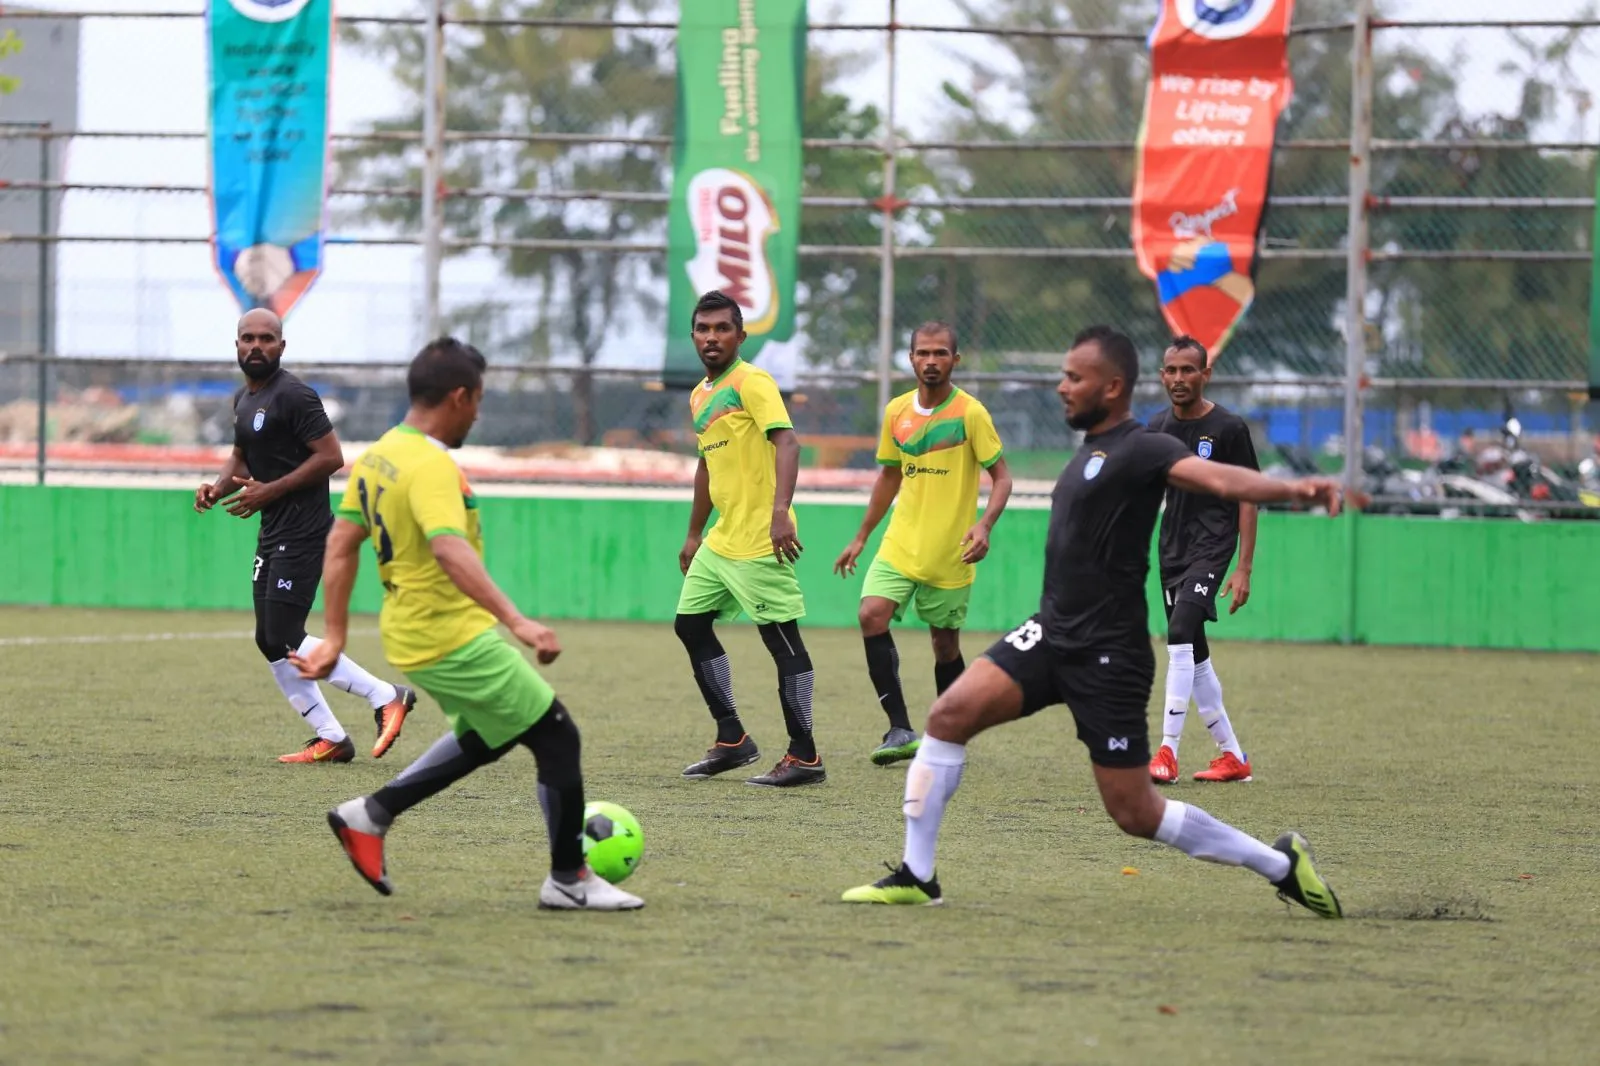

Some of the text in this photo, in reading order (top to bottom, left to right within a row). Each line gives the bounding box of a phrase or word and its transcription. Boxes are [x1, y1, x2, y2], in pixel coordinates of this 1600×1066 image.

[719, 27, 743, 135] Fuelling
[1160, 73, 1277, 101] We rise by
[1174, 99, 1252, 125] Lifting
[1171, 127, 1245, 147] others
[717, 186, 755, 308] MILO
